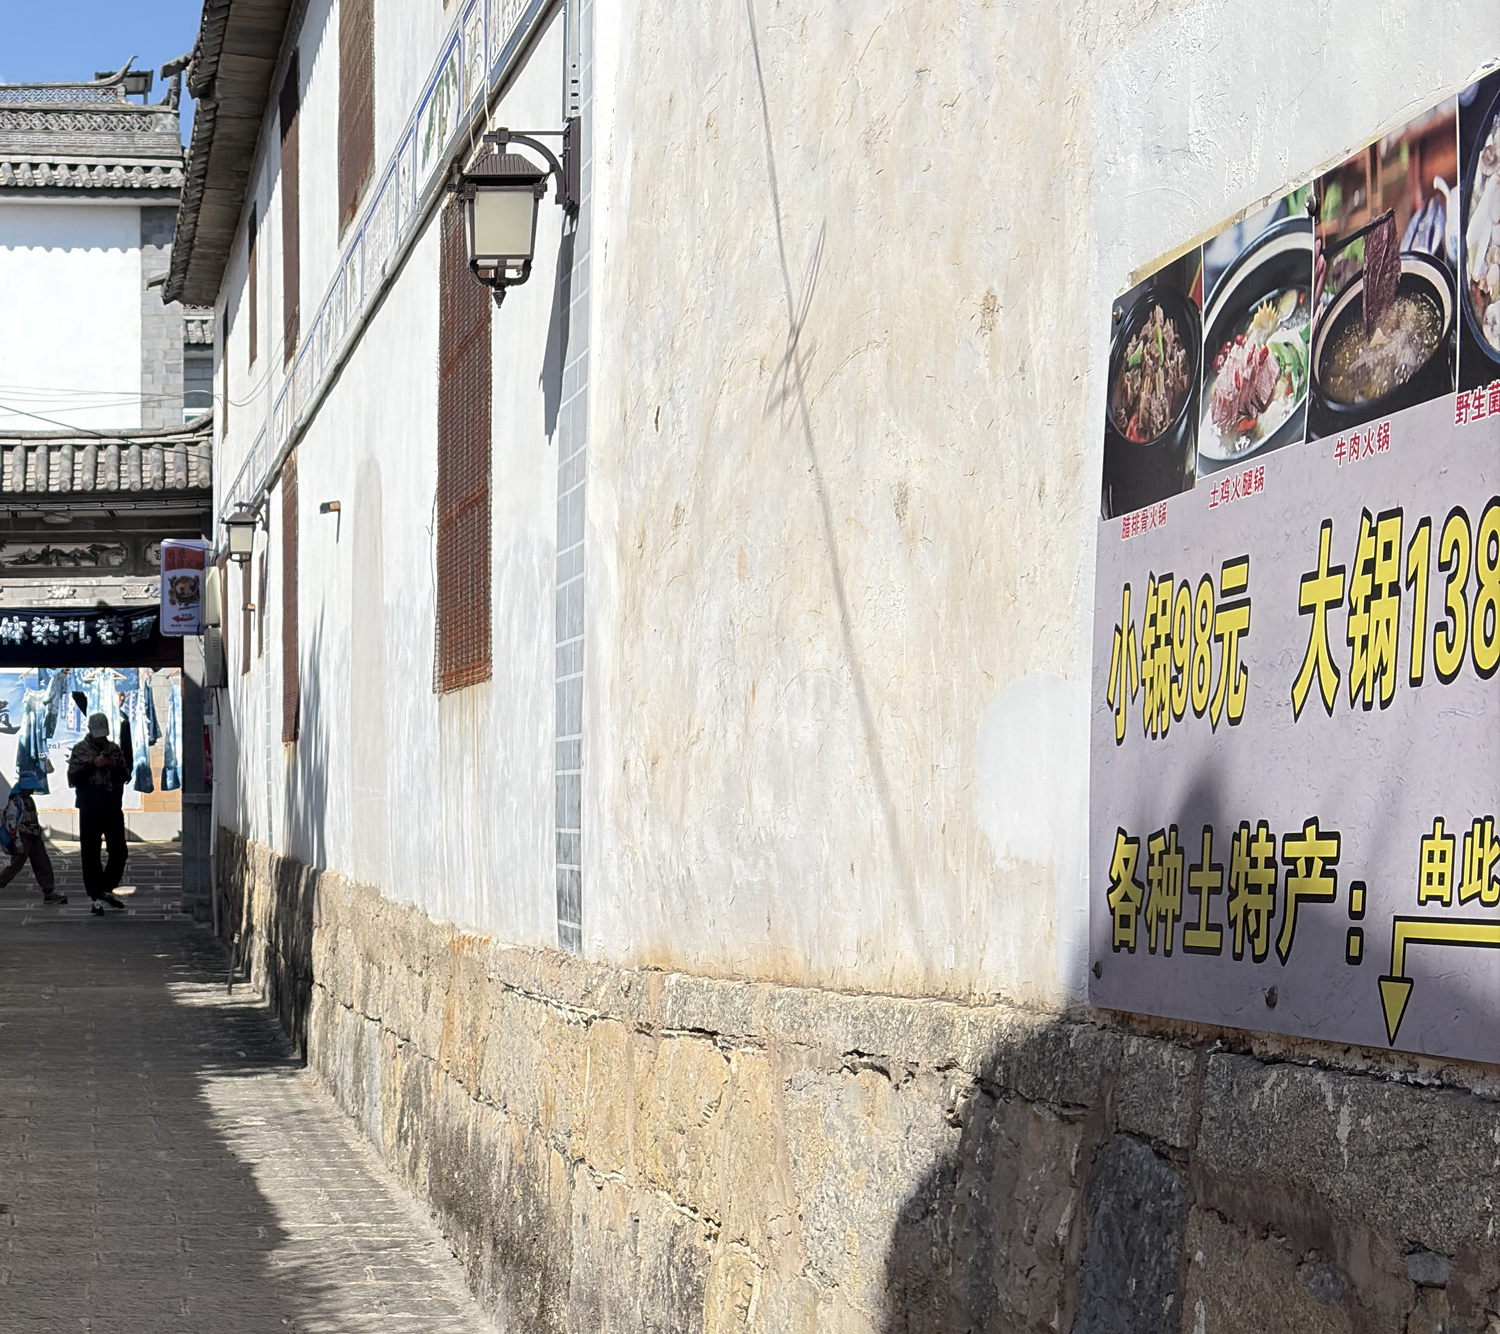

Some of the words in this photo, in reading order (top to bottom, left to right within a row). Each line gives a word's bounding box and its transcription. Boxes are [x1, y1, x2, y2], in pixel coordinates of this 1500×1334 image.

[1334, 420, 1391, 467] 牛肉火锅
[1120, 502, 1168, 540] 腊排骨火锅
[1208, 465, 1266, 510] 土鸡火腿锅
[1106, 554, 1252, 746] 小锅98元
[1290, 495, 1500, 723] 大锅138
[1106, 816, 1367, 966] 各种土特产：
[1417, 815, 1500, 908] 由此
